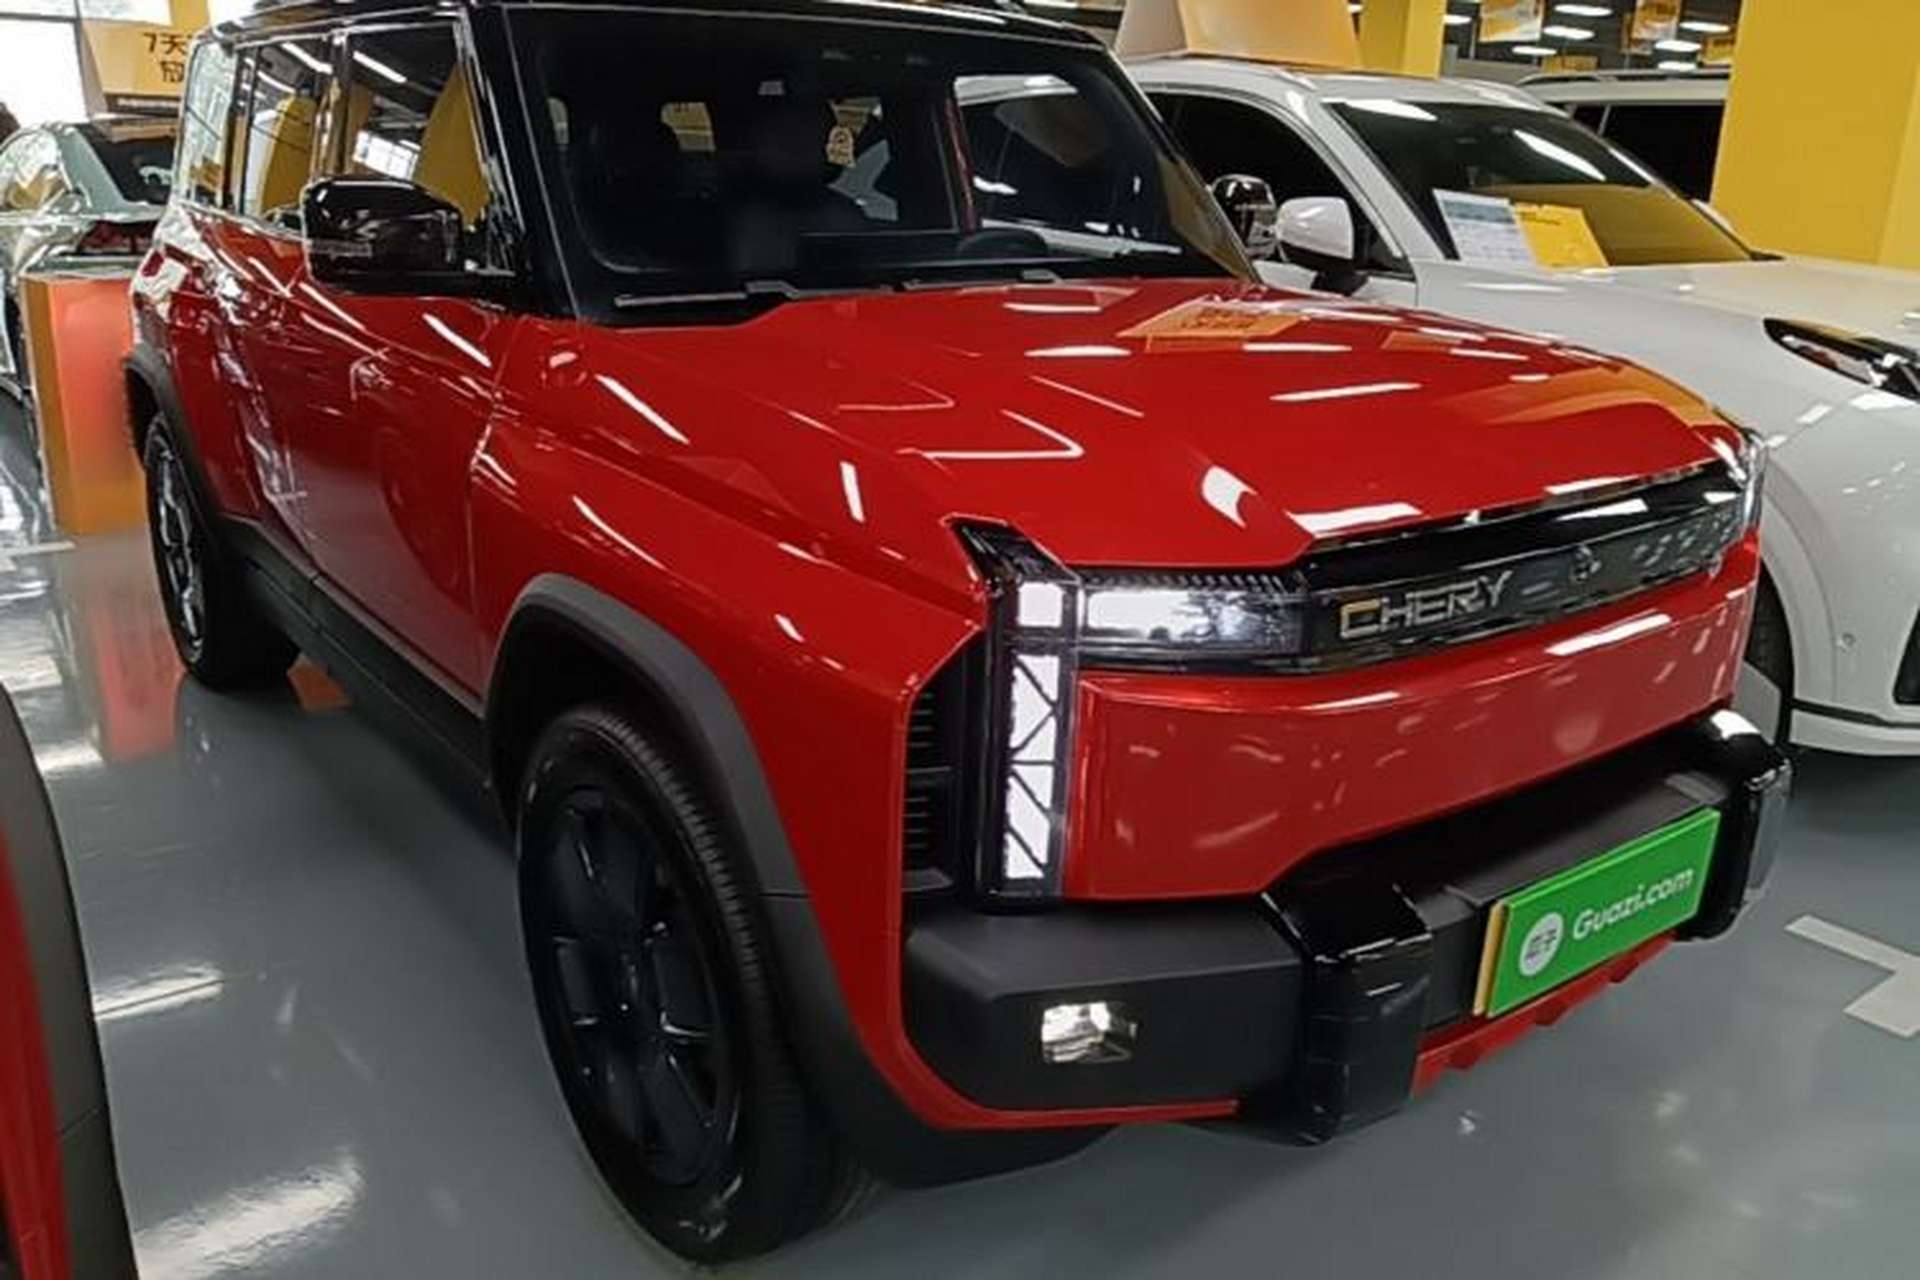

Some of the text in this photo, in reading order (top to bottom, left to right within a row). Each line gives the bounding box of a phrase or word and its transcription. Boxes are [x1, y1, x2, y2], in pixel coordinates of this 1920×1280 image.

[143, 32, 192, 55] 7天
[1340, 570, 1513, 639] CHERY
[1572, 868, 1694, 941] Guazi.com
